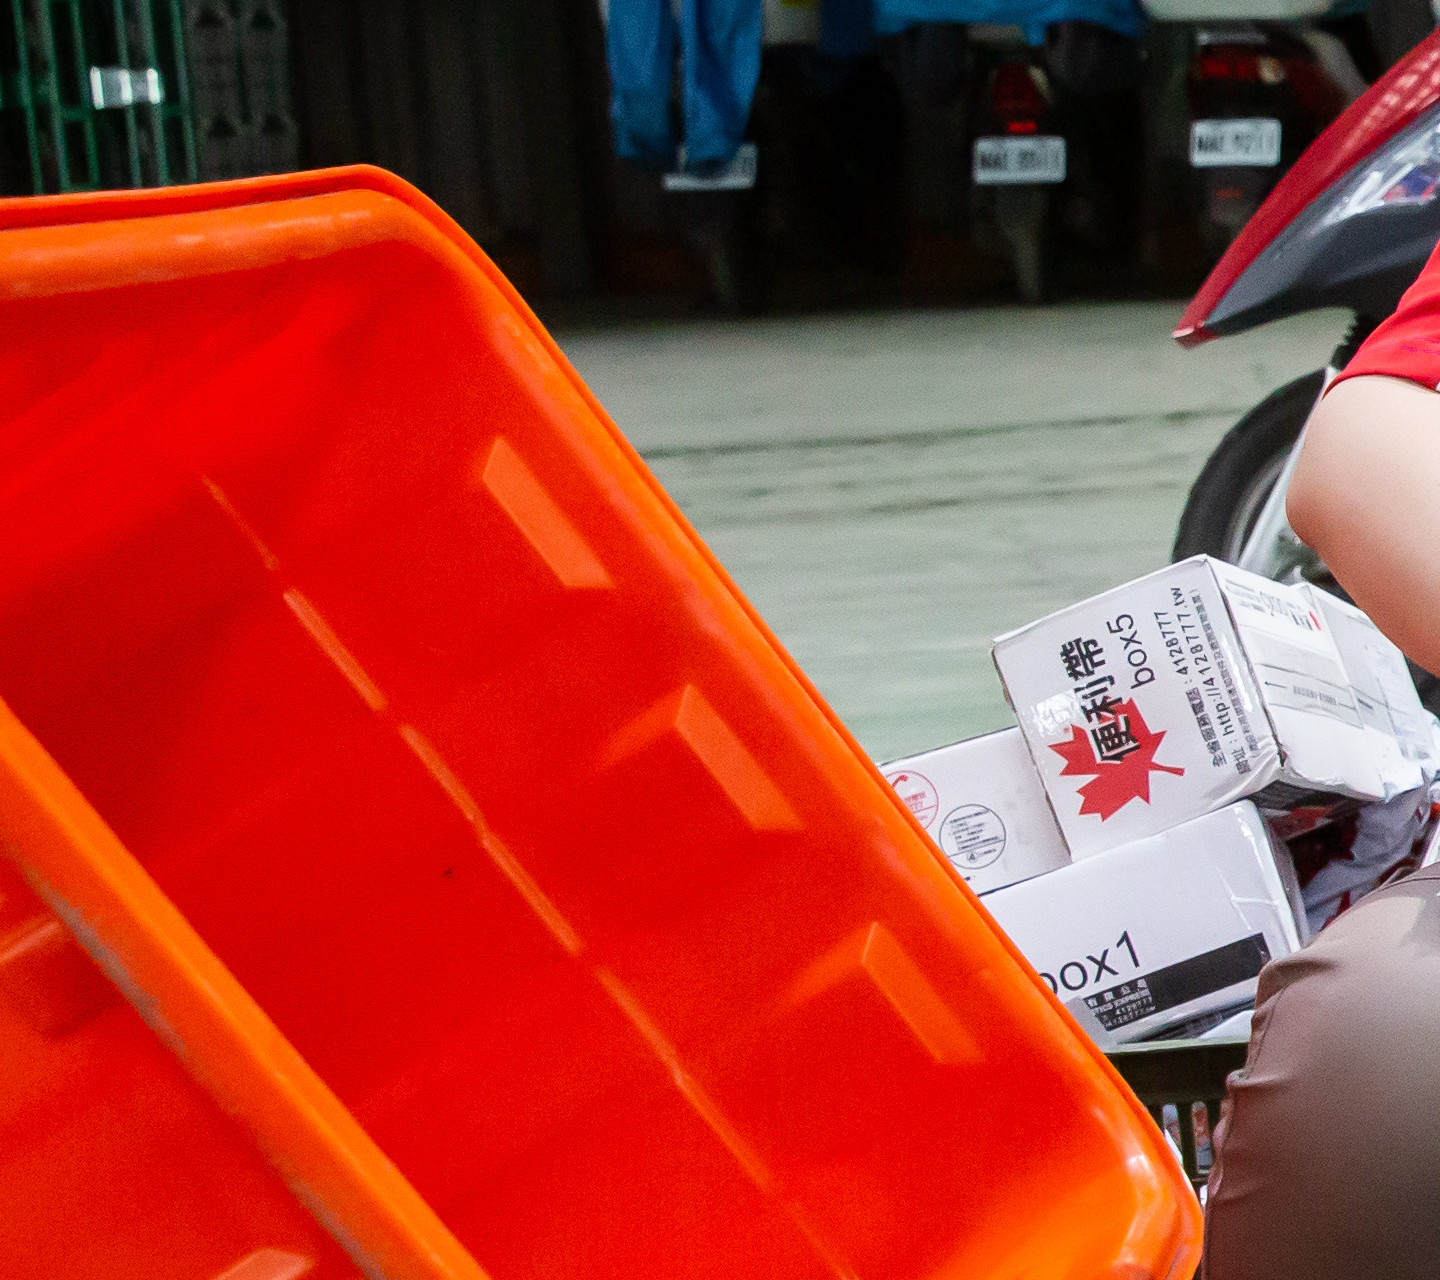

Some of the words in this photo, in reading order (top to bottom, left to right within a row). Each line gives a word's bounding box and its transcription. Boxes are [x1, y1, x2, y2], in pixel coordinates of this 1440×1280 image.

[1060, 636, 1140, 762] 便利帶
[1106, 613, 1155, 689] box5
